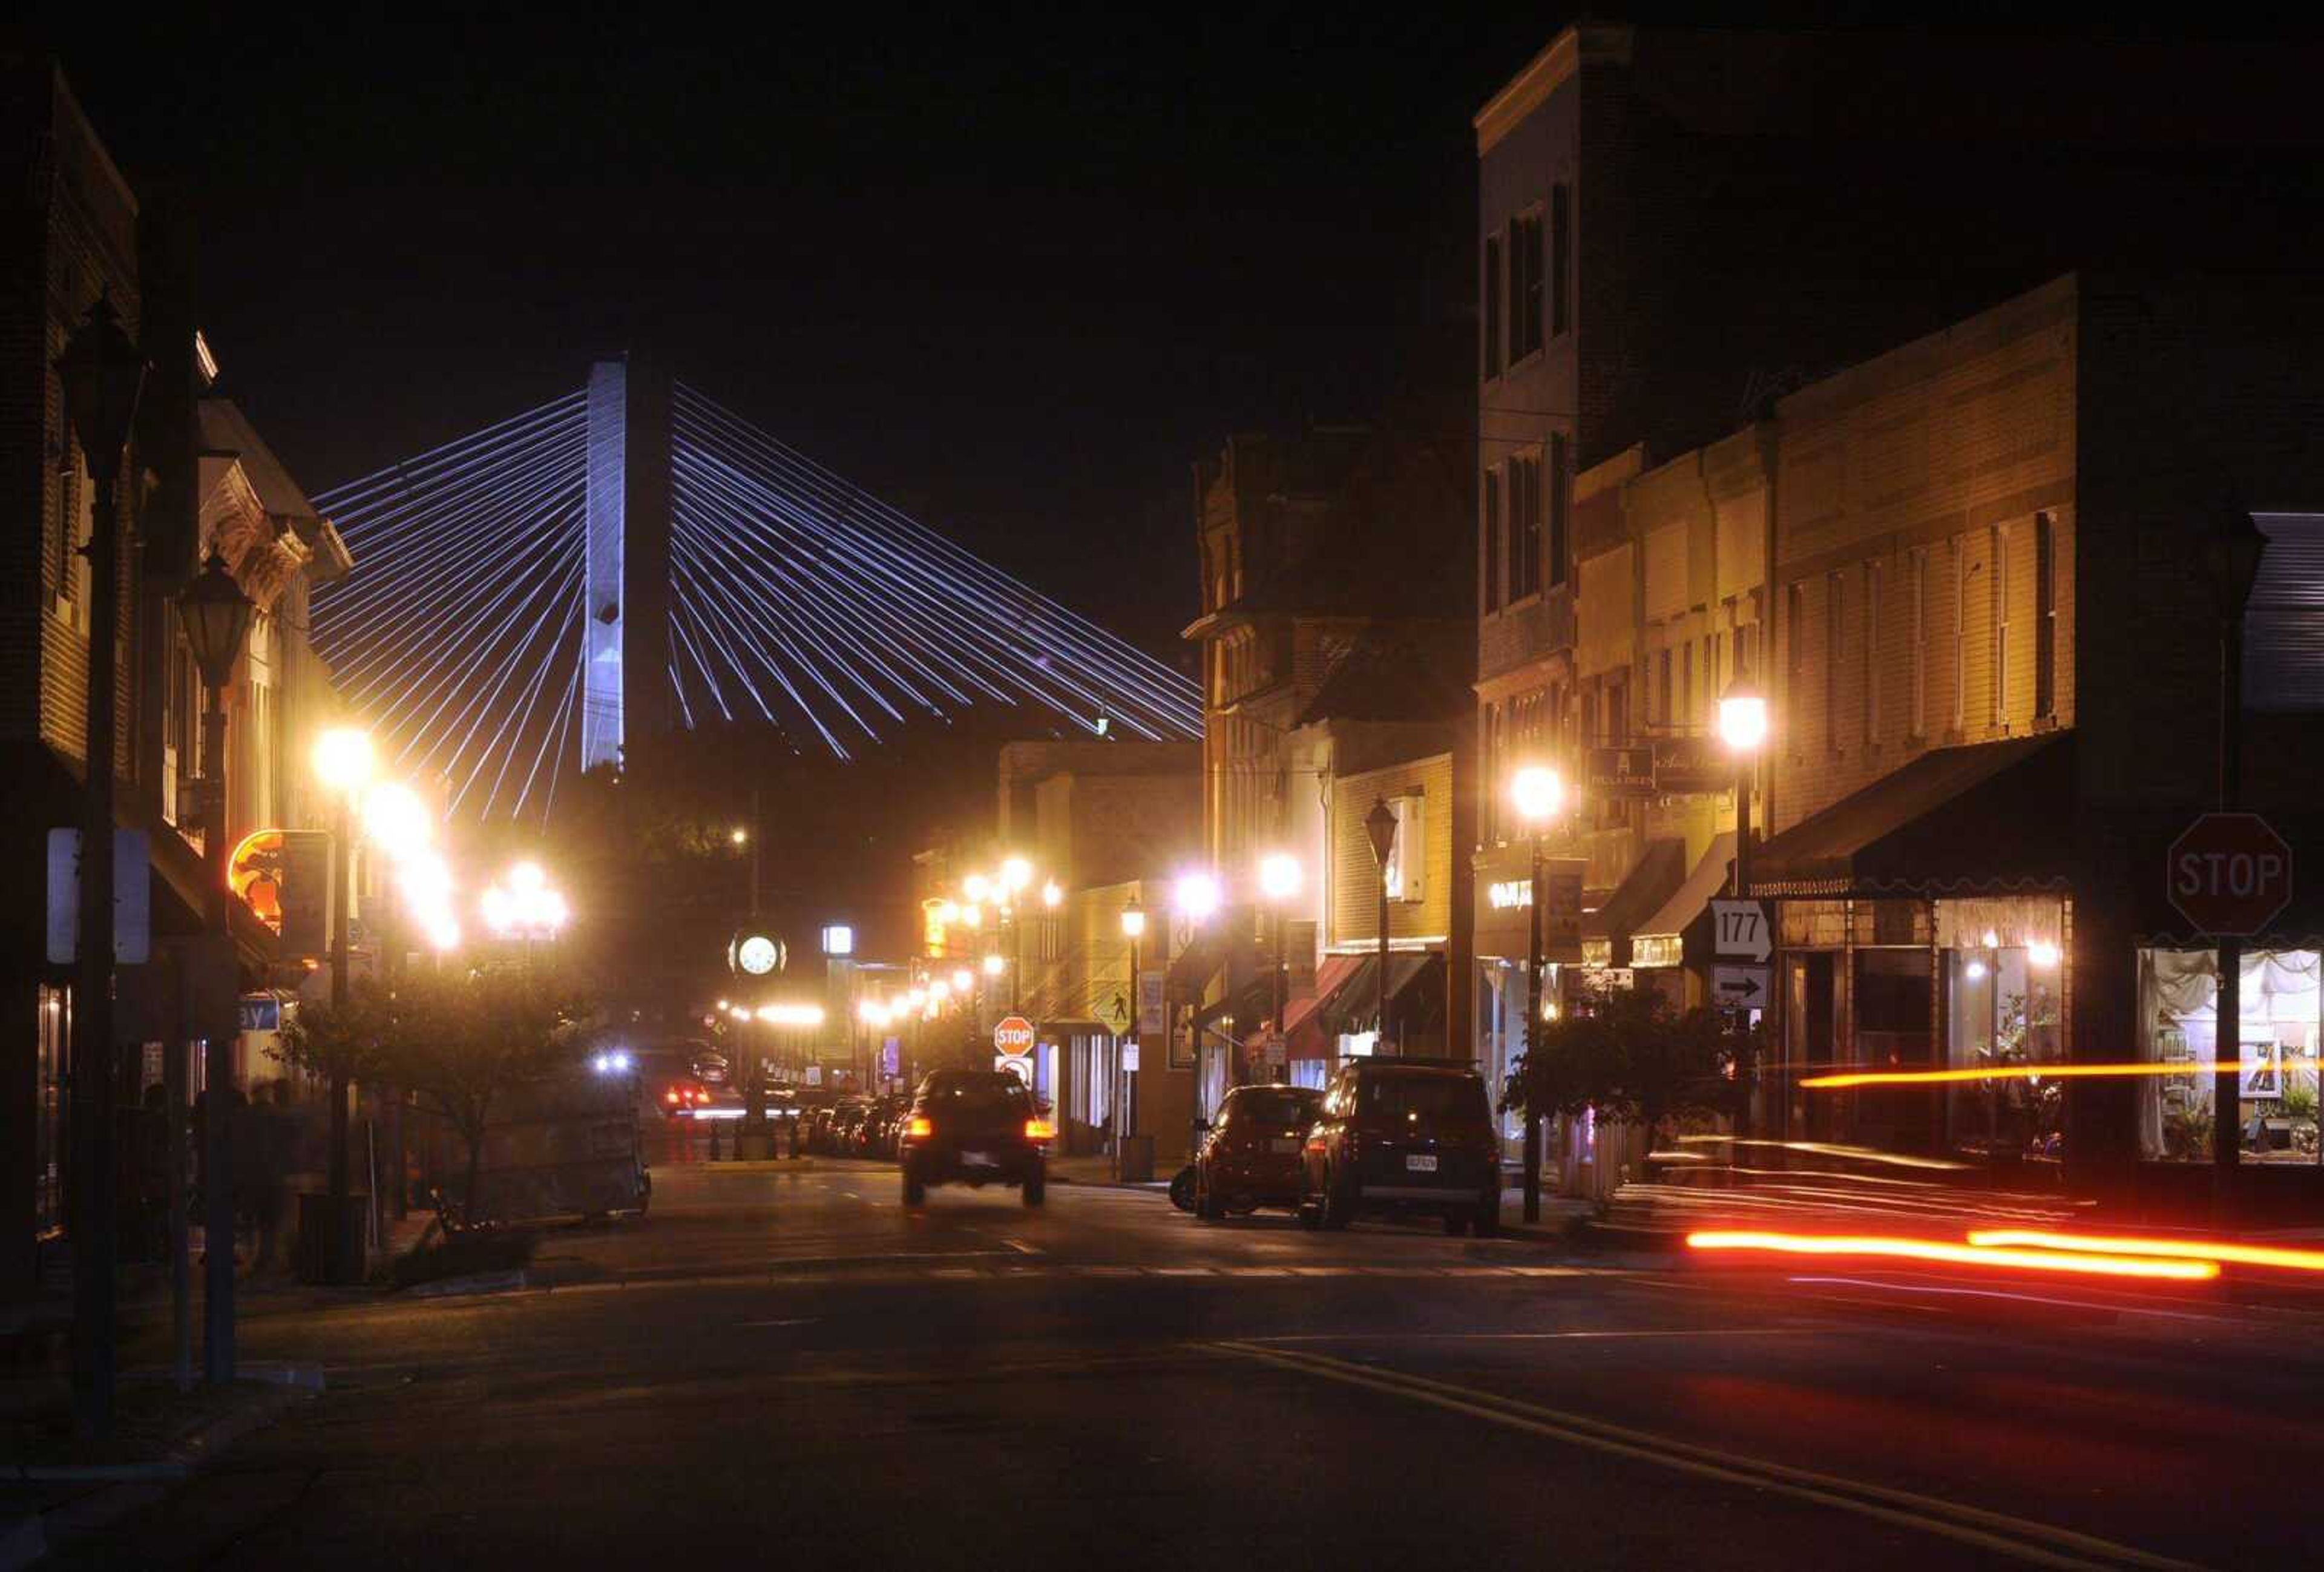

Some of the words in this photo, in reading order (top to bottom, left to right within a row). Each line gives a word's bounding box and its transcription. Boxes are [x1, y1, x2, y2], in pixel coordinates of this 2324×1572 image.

[2178, 853, 2281, 896] STOP
[1722, 912, 1759, 942] 177
[999, 1030, 1031, 1044] STOP
